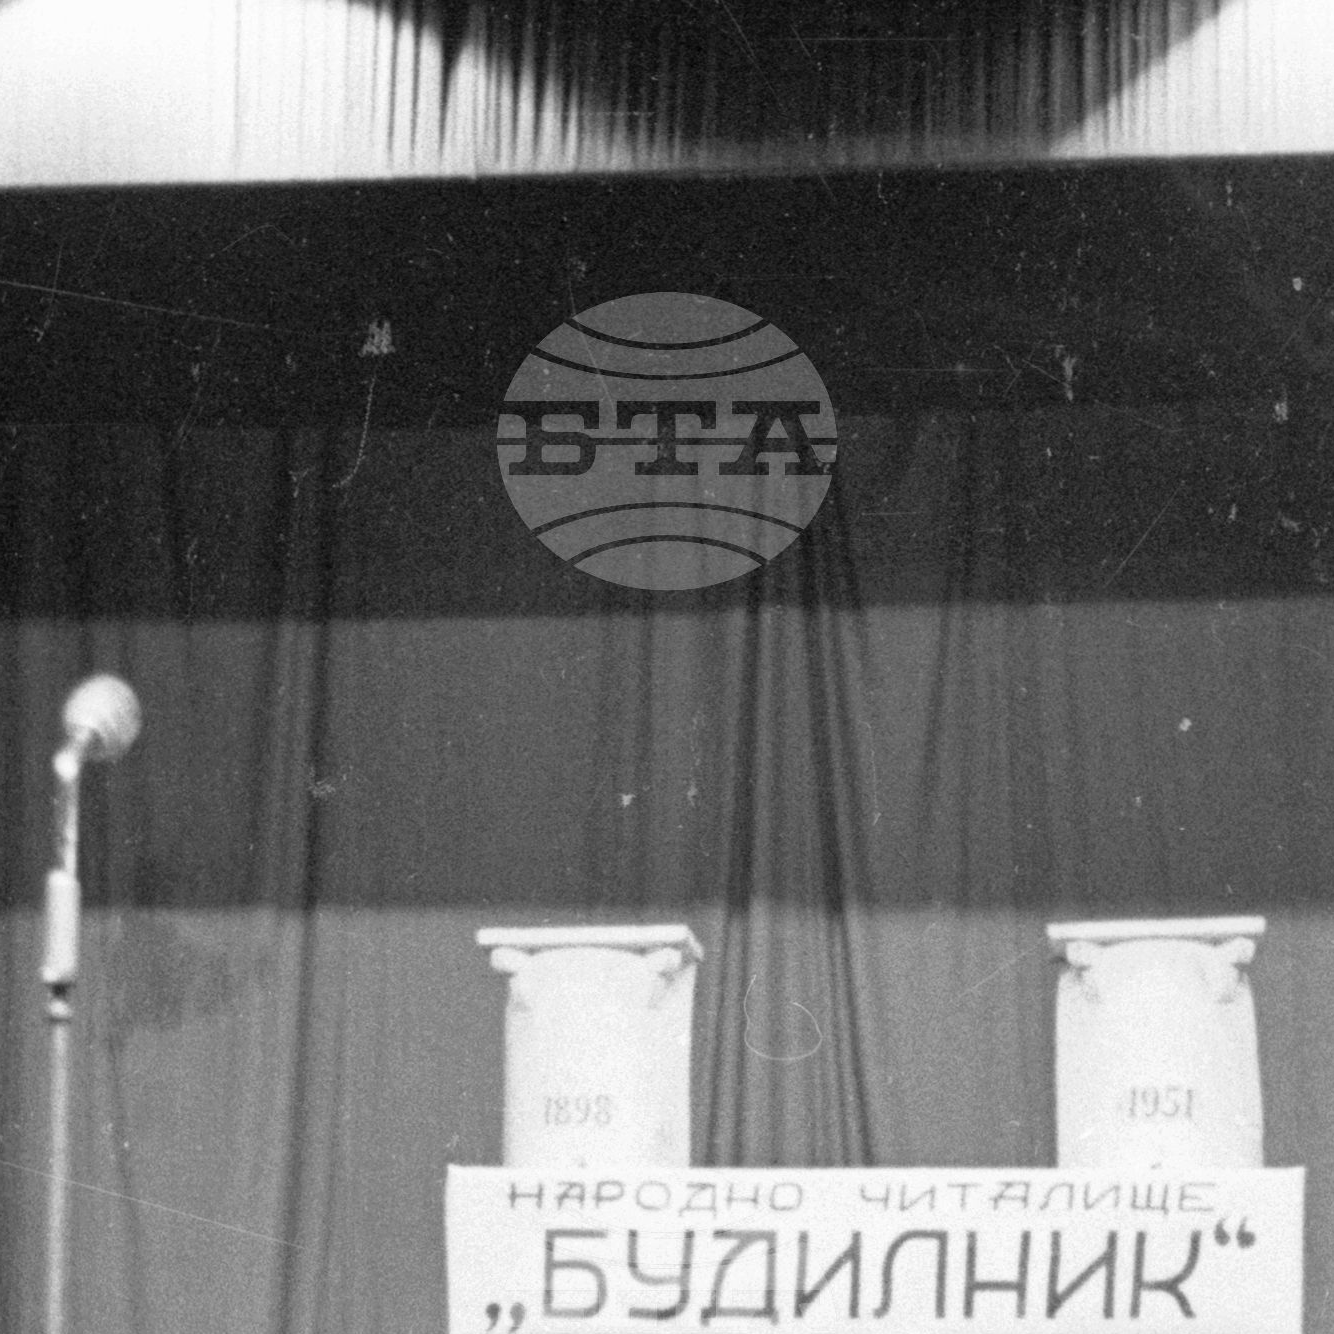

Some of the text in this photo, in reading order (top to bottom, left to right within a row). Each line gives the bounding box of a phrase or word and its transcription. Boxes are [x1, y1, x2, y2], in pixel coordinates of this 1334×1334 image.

[543, 1095, 612, 1126] 1898
[1128, 1087, 1195, 1119] 1951
[506, 1180, 1217, 1216] НАРОДНО ЧИТАЛИЩЕ
